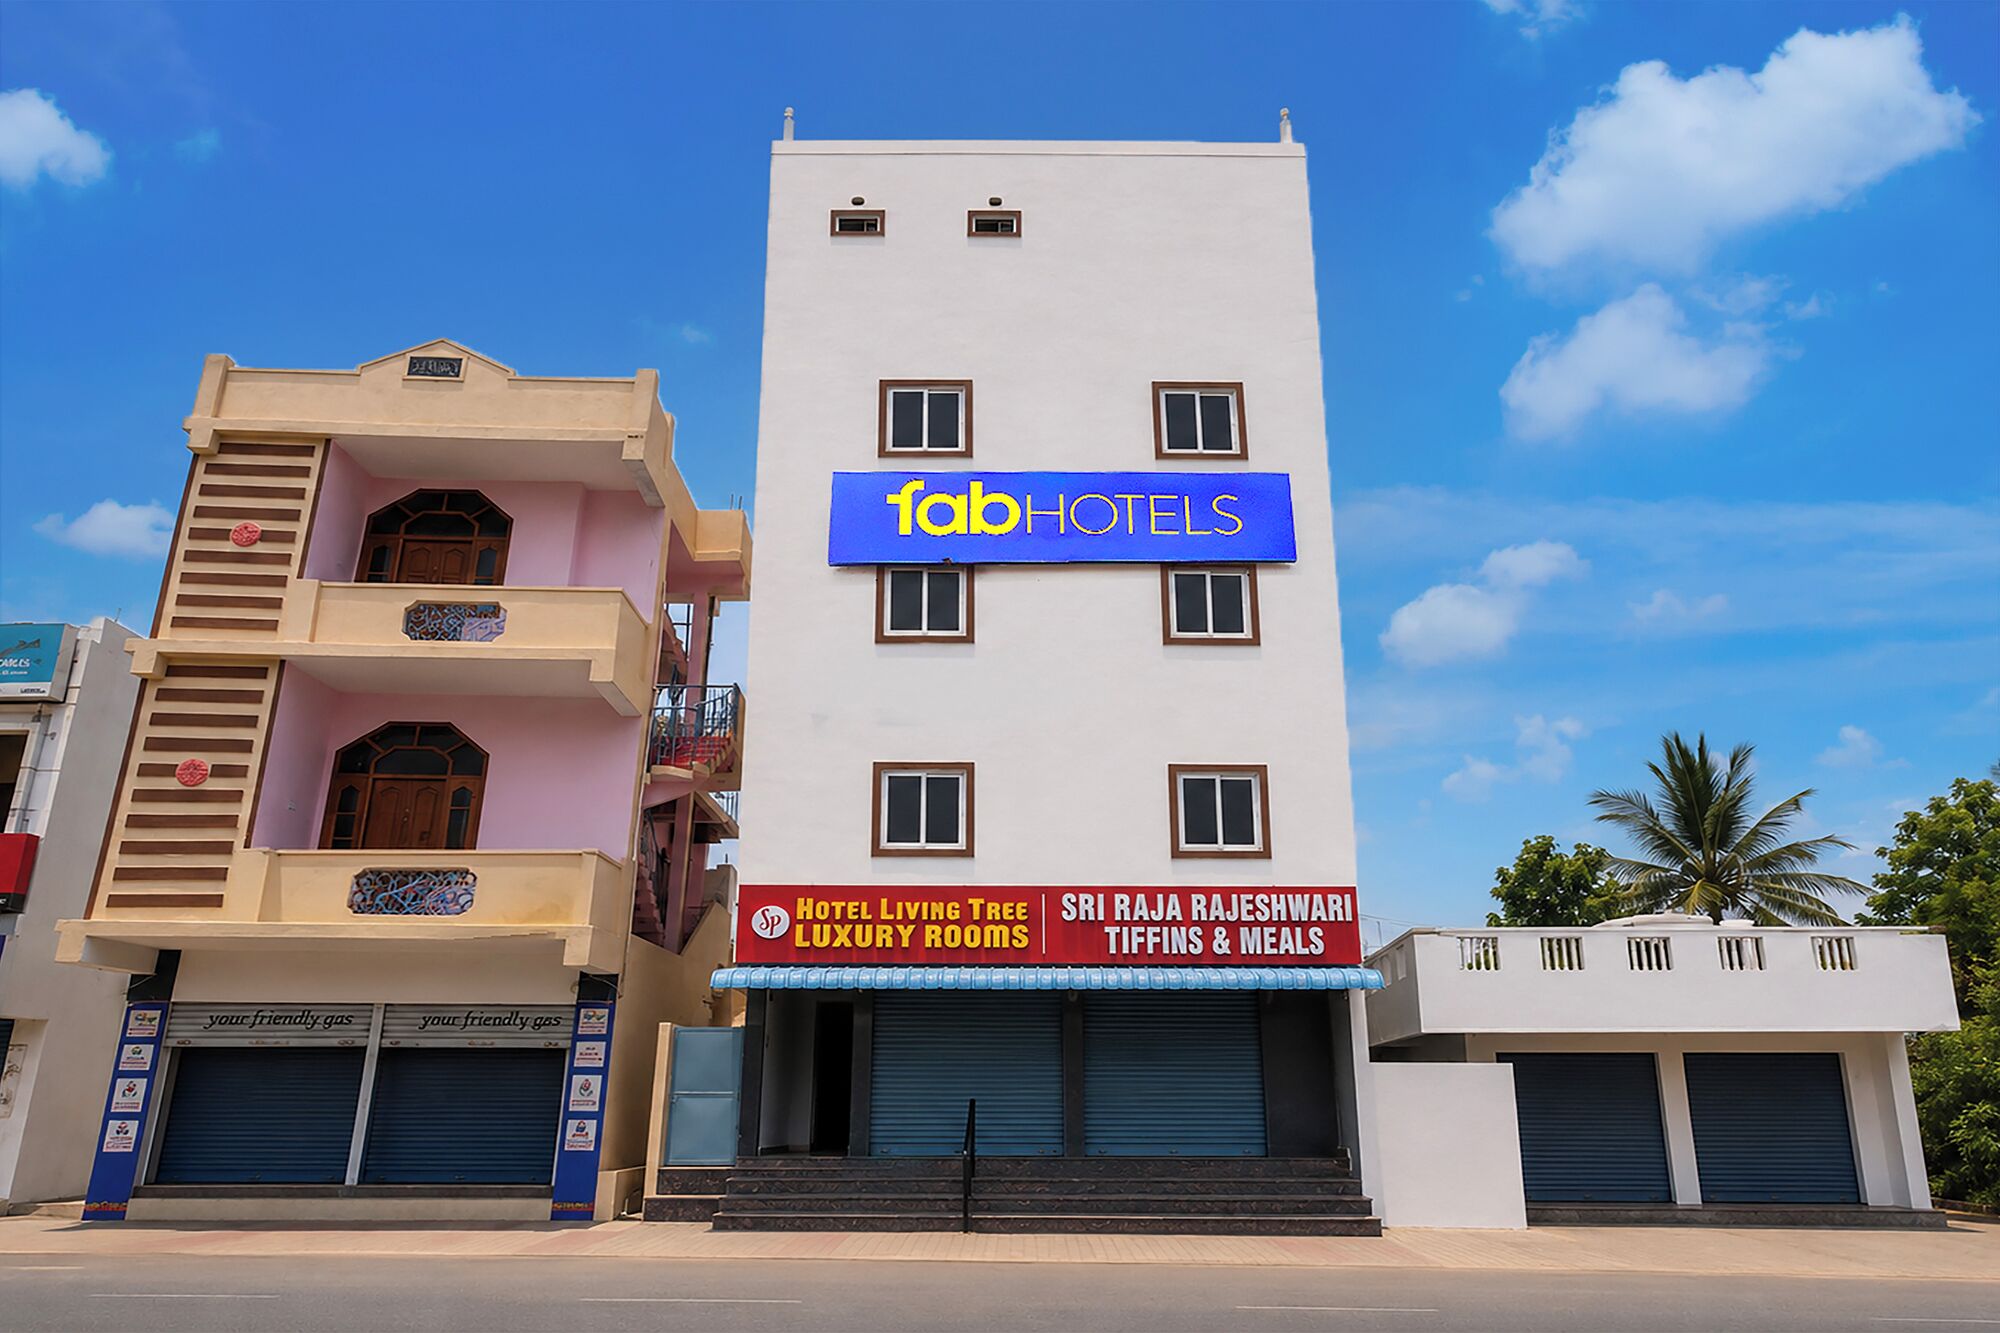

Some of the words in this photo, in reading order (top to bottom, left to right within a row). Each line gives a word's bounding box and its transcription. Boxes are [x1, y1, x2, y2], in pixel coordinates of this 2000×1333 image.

[1060, 892, 1105, 922] SRI
[1114, 892, 1183, 922] RAJA
[1190, 893, 1353, 922] RAJESHWARI
[795, 924, 916, 949] LUXURY
[924, 924, 1029, 949] ROOMS
[1104, 926, 1204, 955] TIFFINS
[1212, 926, 1232, 955] &
[1240, 927, 1325, 955] MEALS
[203, 1014, 249, 1030] your
[248, 1009, 320, 1030] friendly
[322, 1014, 355, 1030] gas
[418, 1015, 461, 1031] your
[460, 1010, 530, 1031] friendly
[531, 1015, 563, 1031] gas
